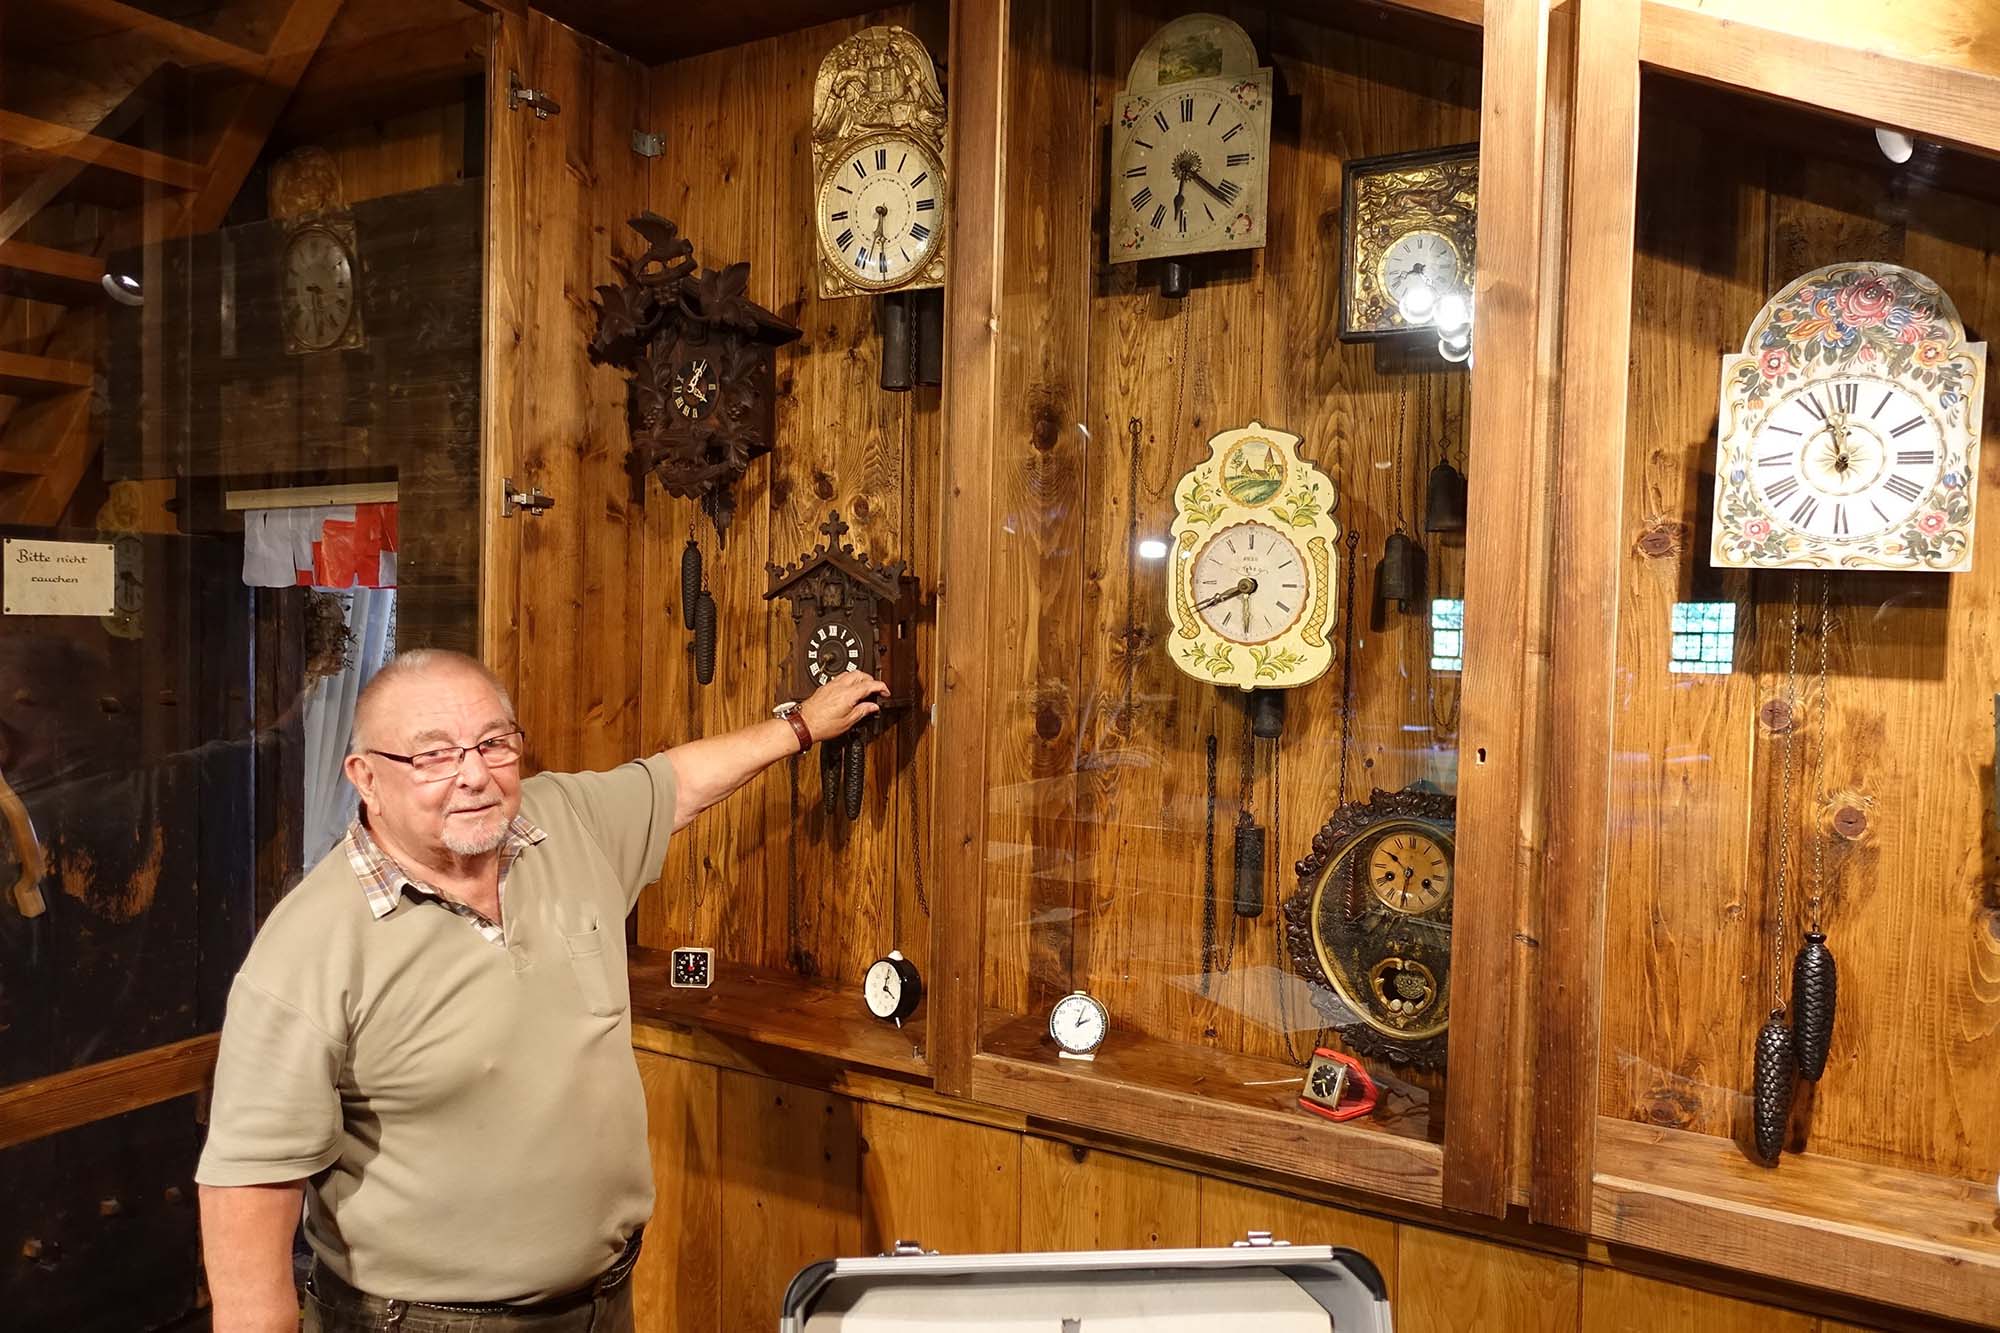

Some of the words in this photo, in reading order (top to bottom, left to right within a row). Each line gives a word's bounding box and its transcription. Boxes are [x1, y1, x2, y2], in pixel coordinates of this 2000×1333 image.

[16, 549, 52, 564] Bitte
[56, 554, 88, 564] nicht
[31, 575, 79, 584] rauchen
